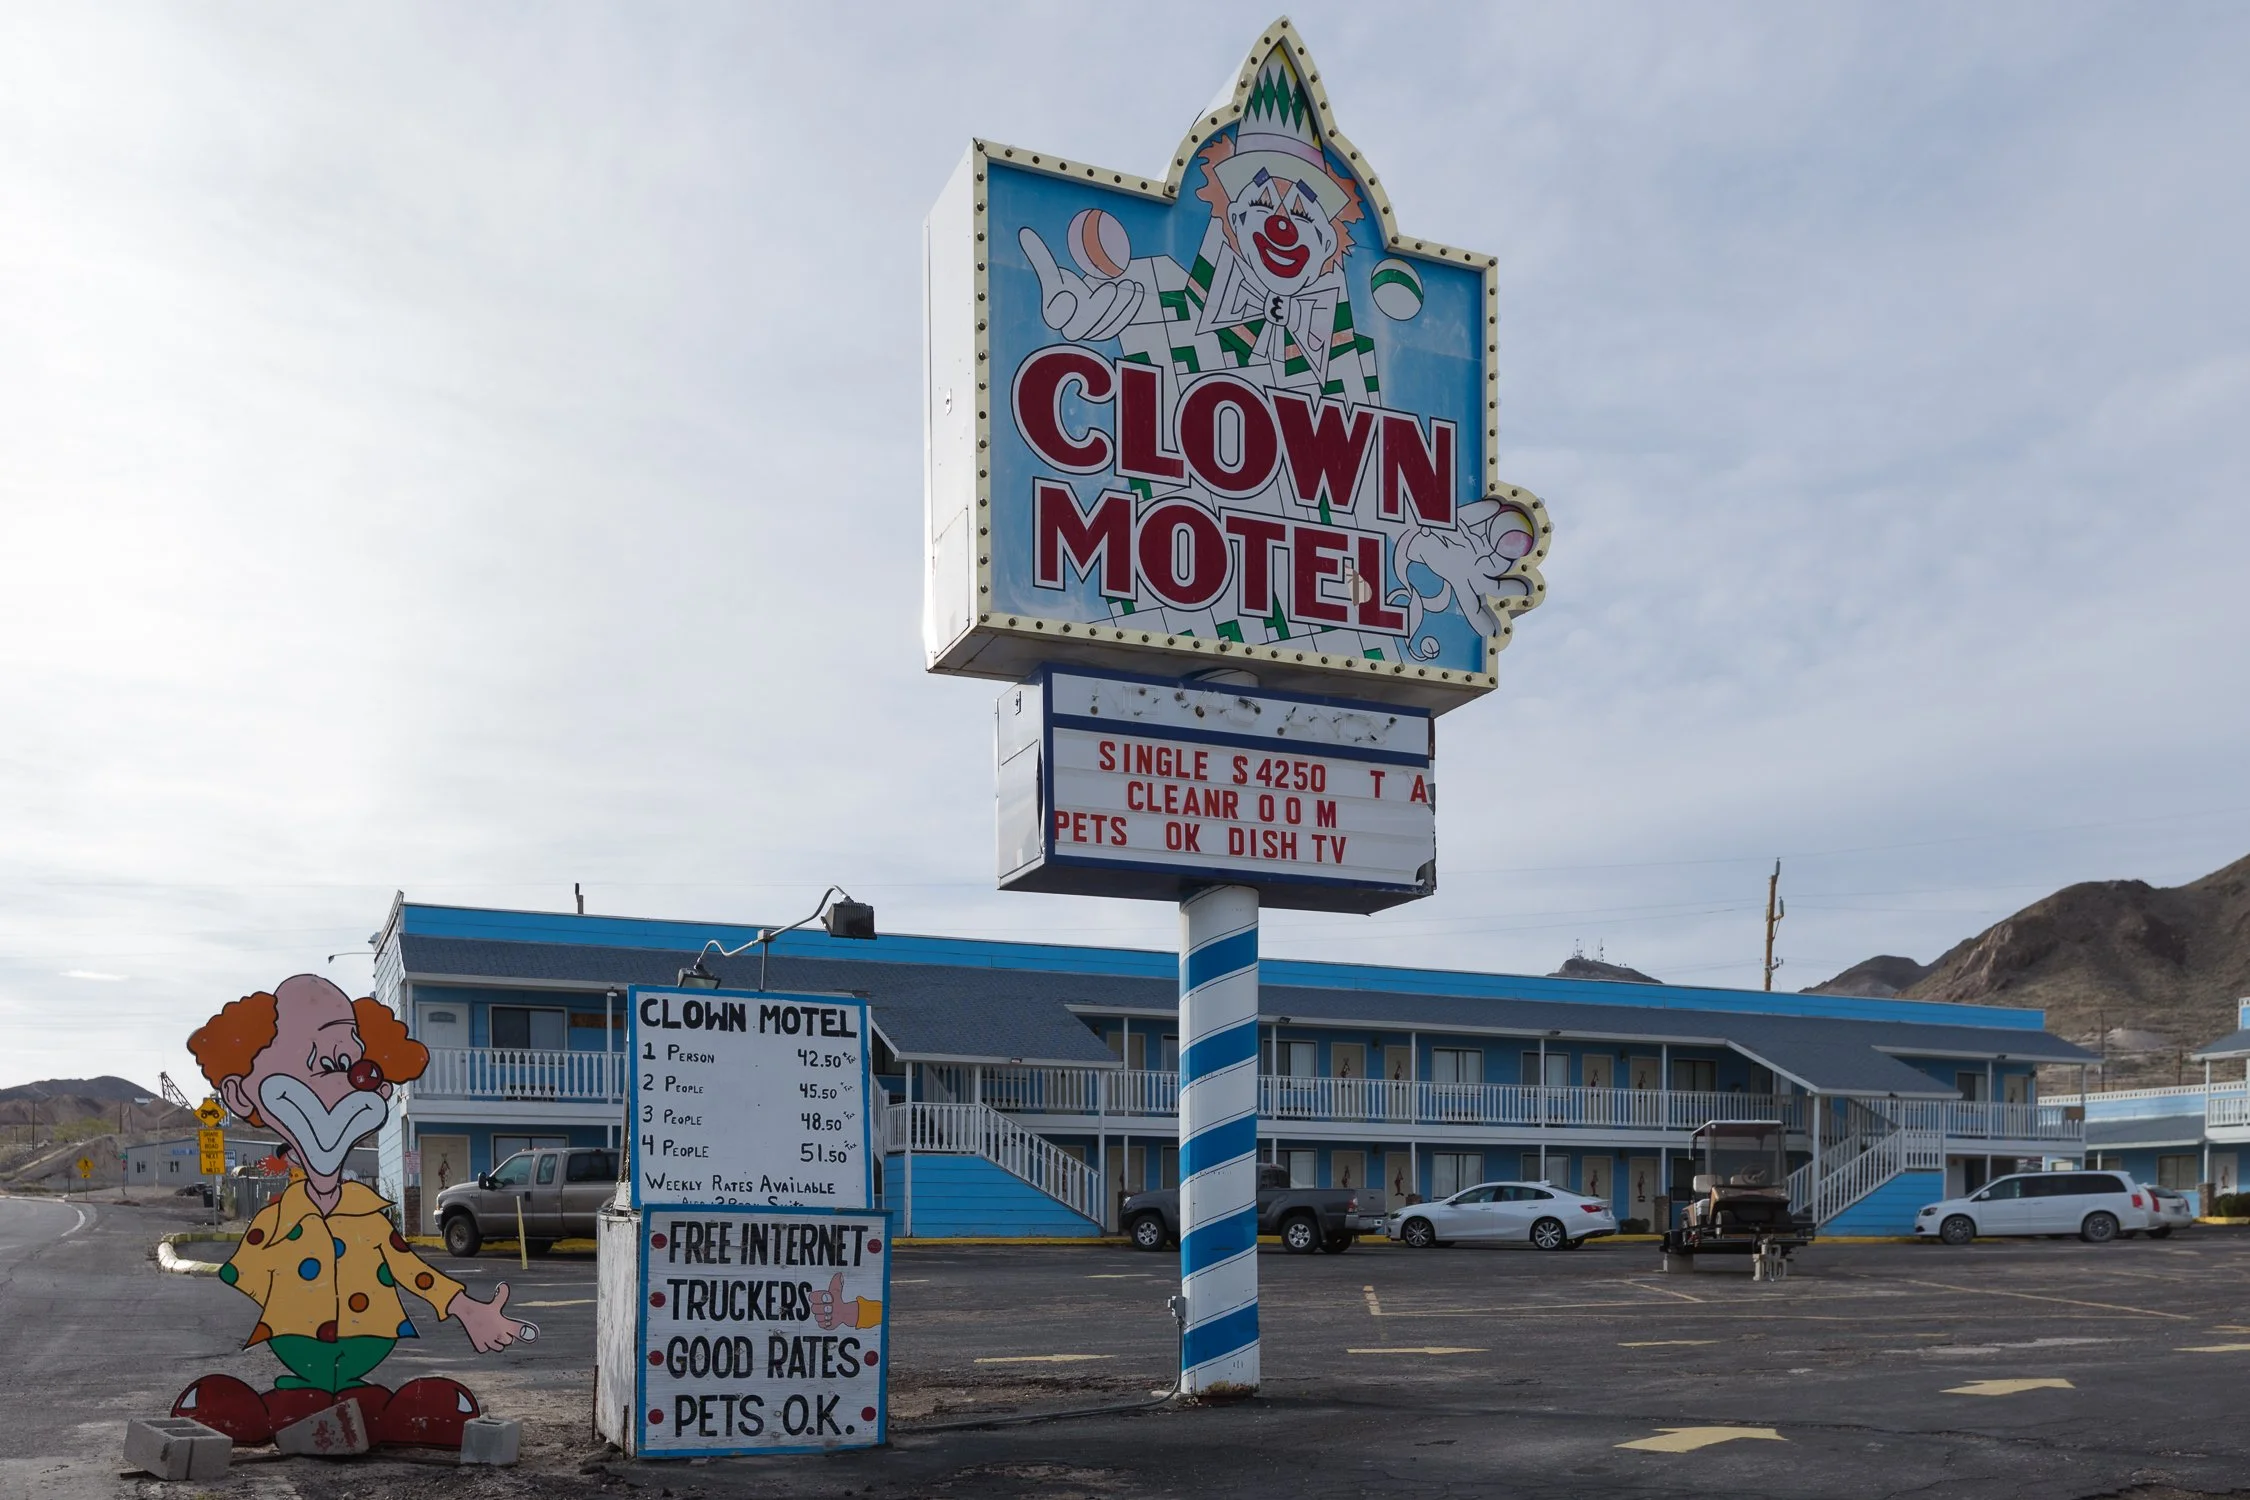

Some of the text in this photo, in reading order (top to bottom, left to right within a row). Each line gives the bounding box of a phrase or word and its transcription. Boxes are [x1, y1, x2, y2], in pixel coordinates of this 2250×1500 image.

[1011, 344, 1457, 529] CLOWN
[1033, 476, 1409, 637] MOTEL
[1099, 740, 1208, 781] SINGLE
[1055, 811, 1347, 864] PETS OK DISH TV
[640, 998, 857, 1038] CLOWN MOTEL
[642, 1042, 656, 1060] 1
[667, 1044, 714, 1063] PERSON
[798, 1049, 841, 1068] 42.50
[643, 1073, 654, 1091] 2
[665, 1075, 704, 1094] PEOPLE
[800, 1083, 837, 1099] 45.50
[642, 1105, 653, 1123] 3
[664, 1109, 702, 1125] PEOPLE
[801, 1112, 842, 1131] 48.50
[642, 1134, 654, 1156] 4
[663, 1139, 709, 1158] PEOPLE
[800, 1142, 847, 1163] 51.50
[645, 1172, 702, 1191] WEEKLY
[712, 1174, 753, 1192] RATES
[668, 1221, 869, 1267] FREE INTERNET
[666, 1279, 812, 1321] TRUCKERS
[666, 1336, 861, 1379] GOOD RATES
[674, 1394, 855, 1437] PETS O.K.
